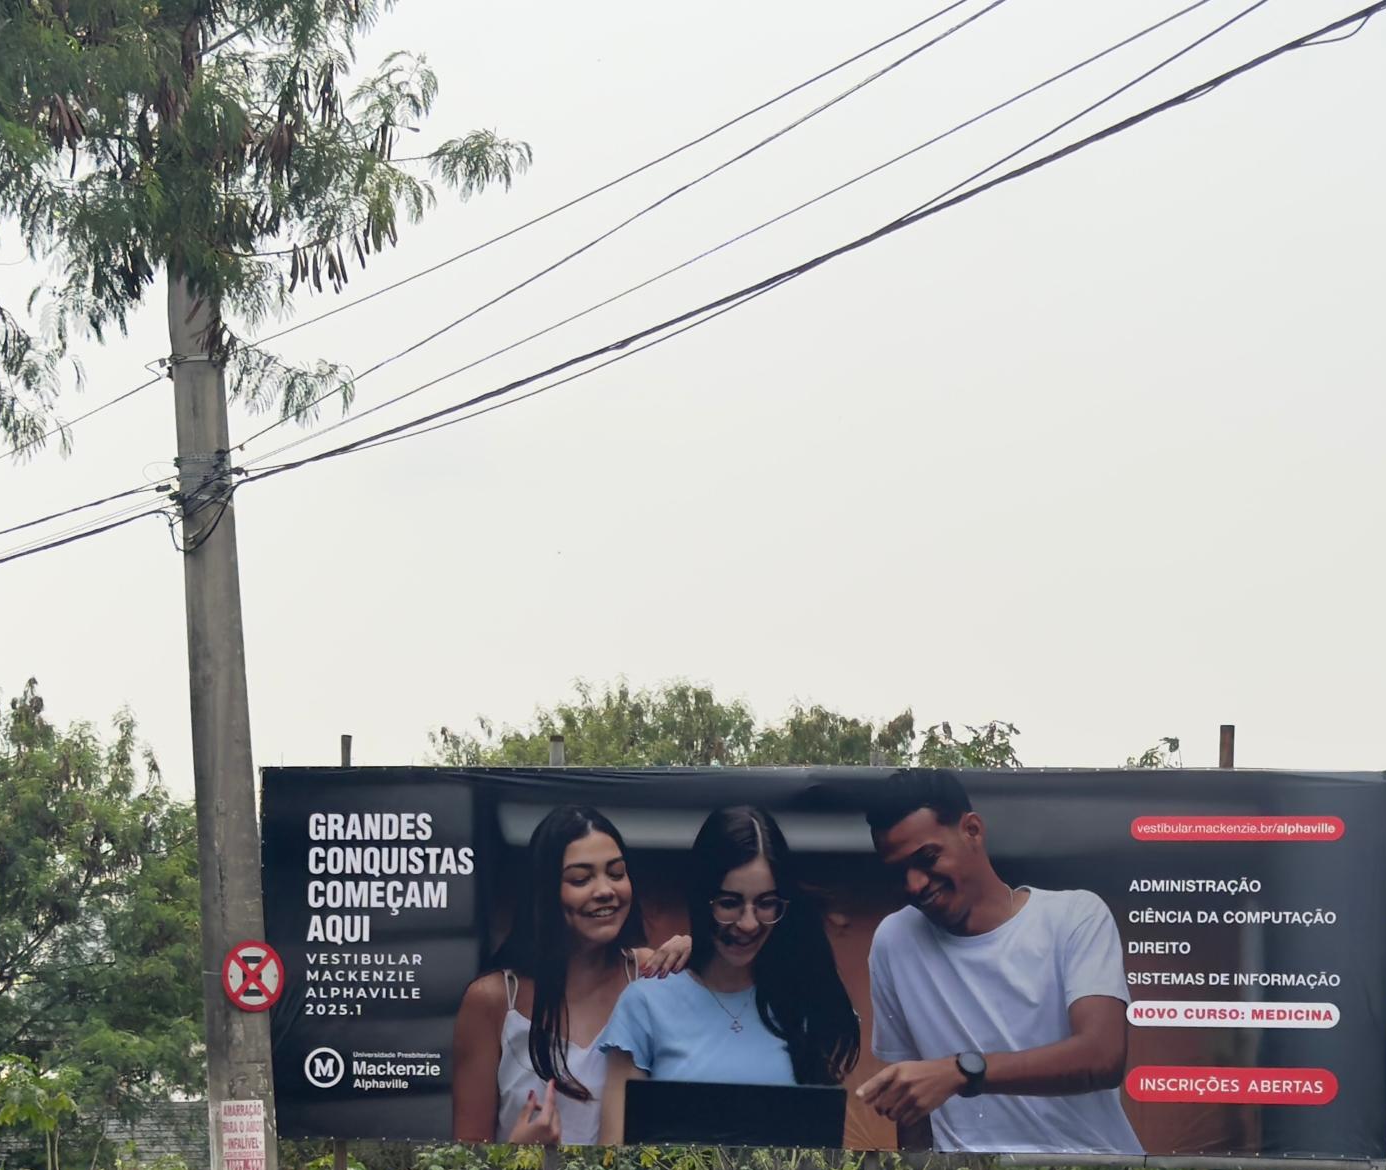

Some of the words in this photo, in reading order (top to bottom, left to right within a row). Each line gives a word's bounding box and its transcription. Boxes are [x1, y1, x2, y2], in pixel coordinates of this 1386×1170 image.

[308, 812, 433, 841] GRANDES
[1136, 821, 1336, 836] vestibular.mackenzie.br/alphaville
[307, 846, 475, 878] CONQUISTAS
[1128, 876, 1262, 896] ADMINISTRAÇÃO
[307, 880, 448, 915] COMEÇAM
[1128, 907, 1193, 926] CIÊNCIA
[1197, 910, 1220, 925] DA
[1222, 907, 1337, 928] COMPUTAÇÃO
[306, 914, 370, 946] AQUI
[1127, 941, 1191, 955] DIREITO
[306, 953, 423, 966] VESTIBULAR
[305, 970, 416, 983] MACKENZIE
[1127, 971, 1206, 987] SISTEMAS
[1208, 972, 1230, 988] DE
[1232, 970, 1342, 990] INFORMAÇÃO
[305, 986, 422, 1000] ALPHAVILLE
[305, 1003, 363, 1017] 2025.1
[1132, 1008, 1177, 1020] NOVO
[1183, 1008, 1246, 1021] CURSO:
[1250, 1008, 1333, 1022] MEDICINA
[352, 1051, 396, 1059] Universidade
[397, 1051, 441, 1059] Presbiteriana
[352, 1060, 441, 1076] Mackenzie
[353, 1078, 409, 1091] Alphaville
[1139, 1075, 1240, 1096] INSCRIÇÕES
[1247, 1078, 1324, 1094] ABERTAS
